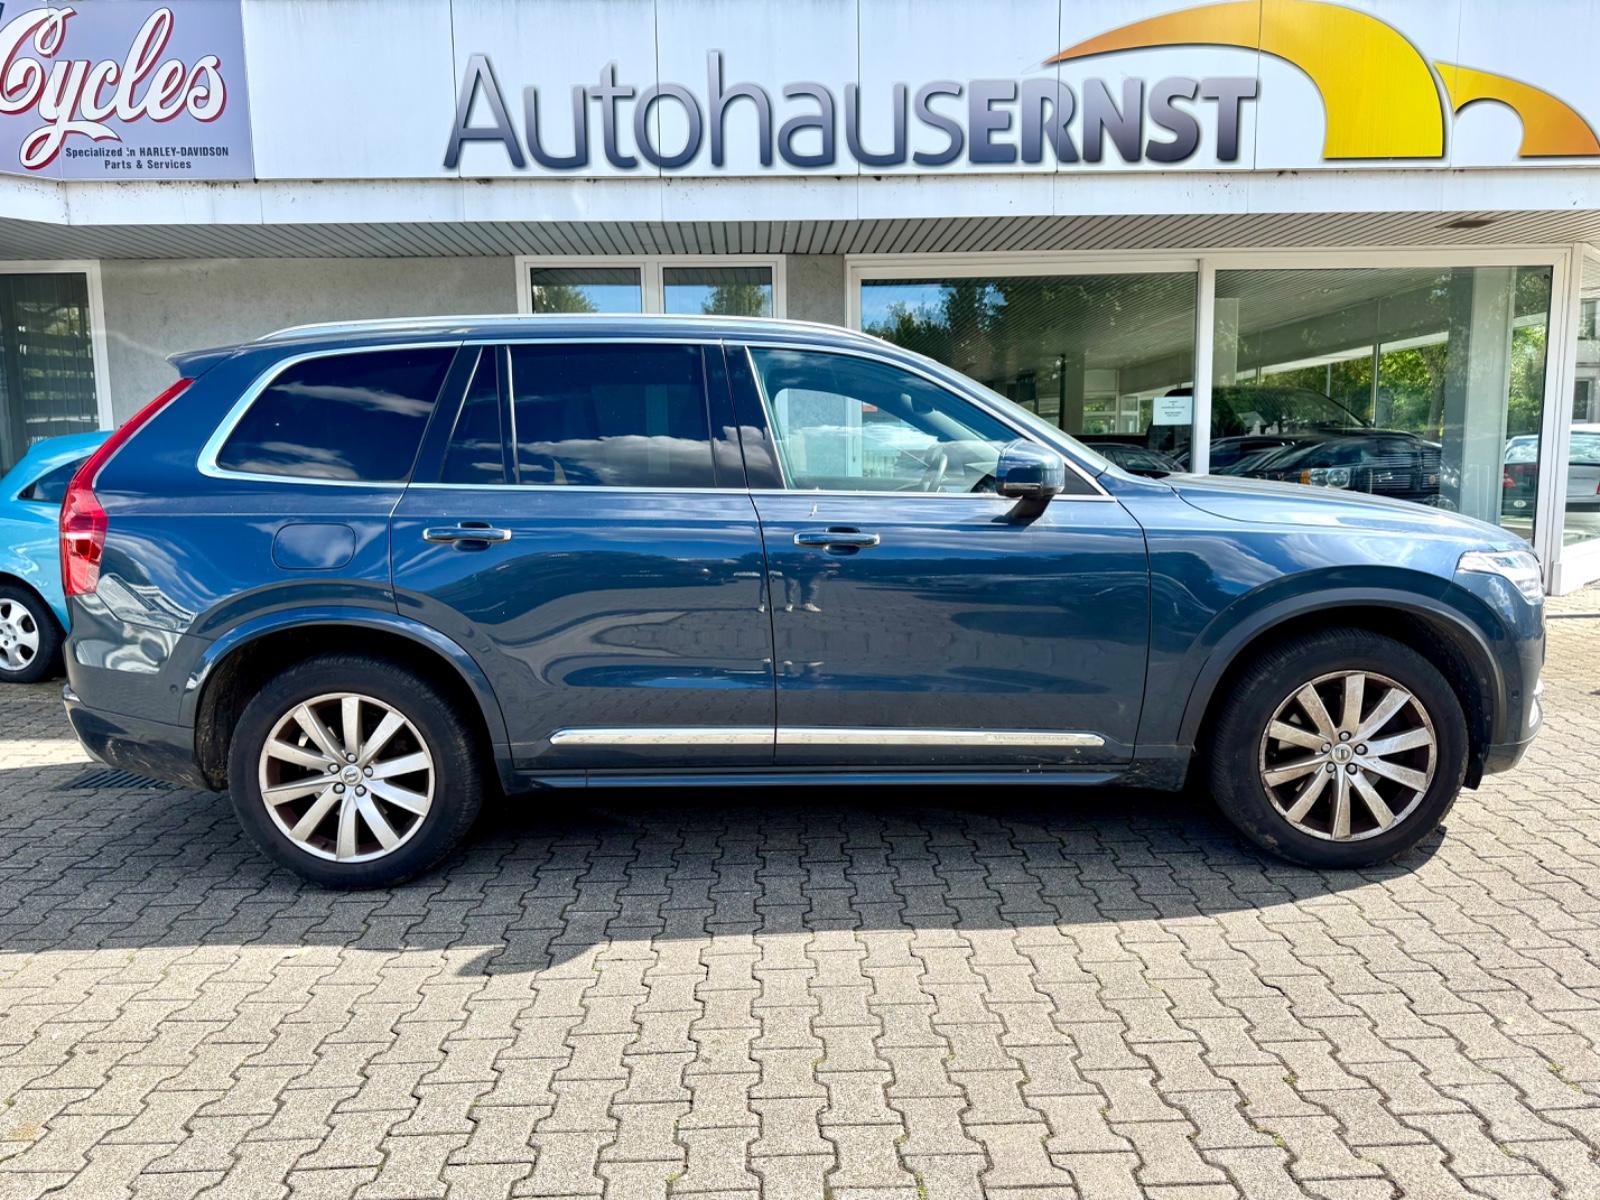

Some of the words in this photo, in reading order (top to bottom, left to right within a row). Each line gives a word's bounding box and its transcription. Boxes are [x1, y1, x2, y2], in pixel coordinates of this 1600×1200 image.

[0, 7, 226, 170] Cycles
[65, 147, 123, 158] Specialized
[139, 146, 229, 157] HARLEY-DAVIDSON
[104, 160, 132, 170] Parts
[136, 160, 143, 169] &
[147, 159, 192, 169] Services
